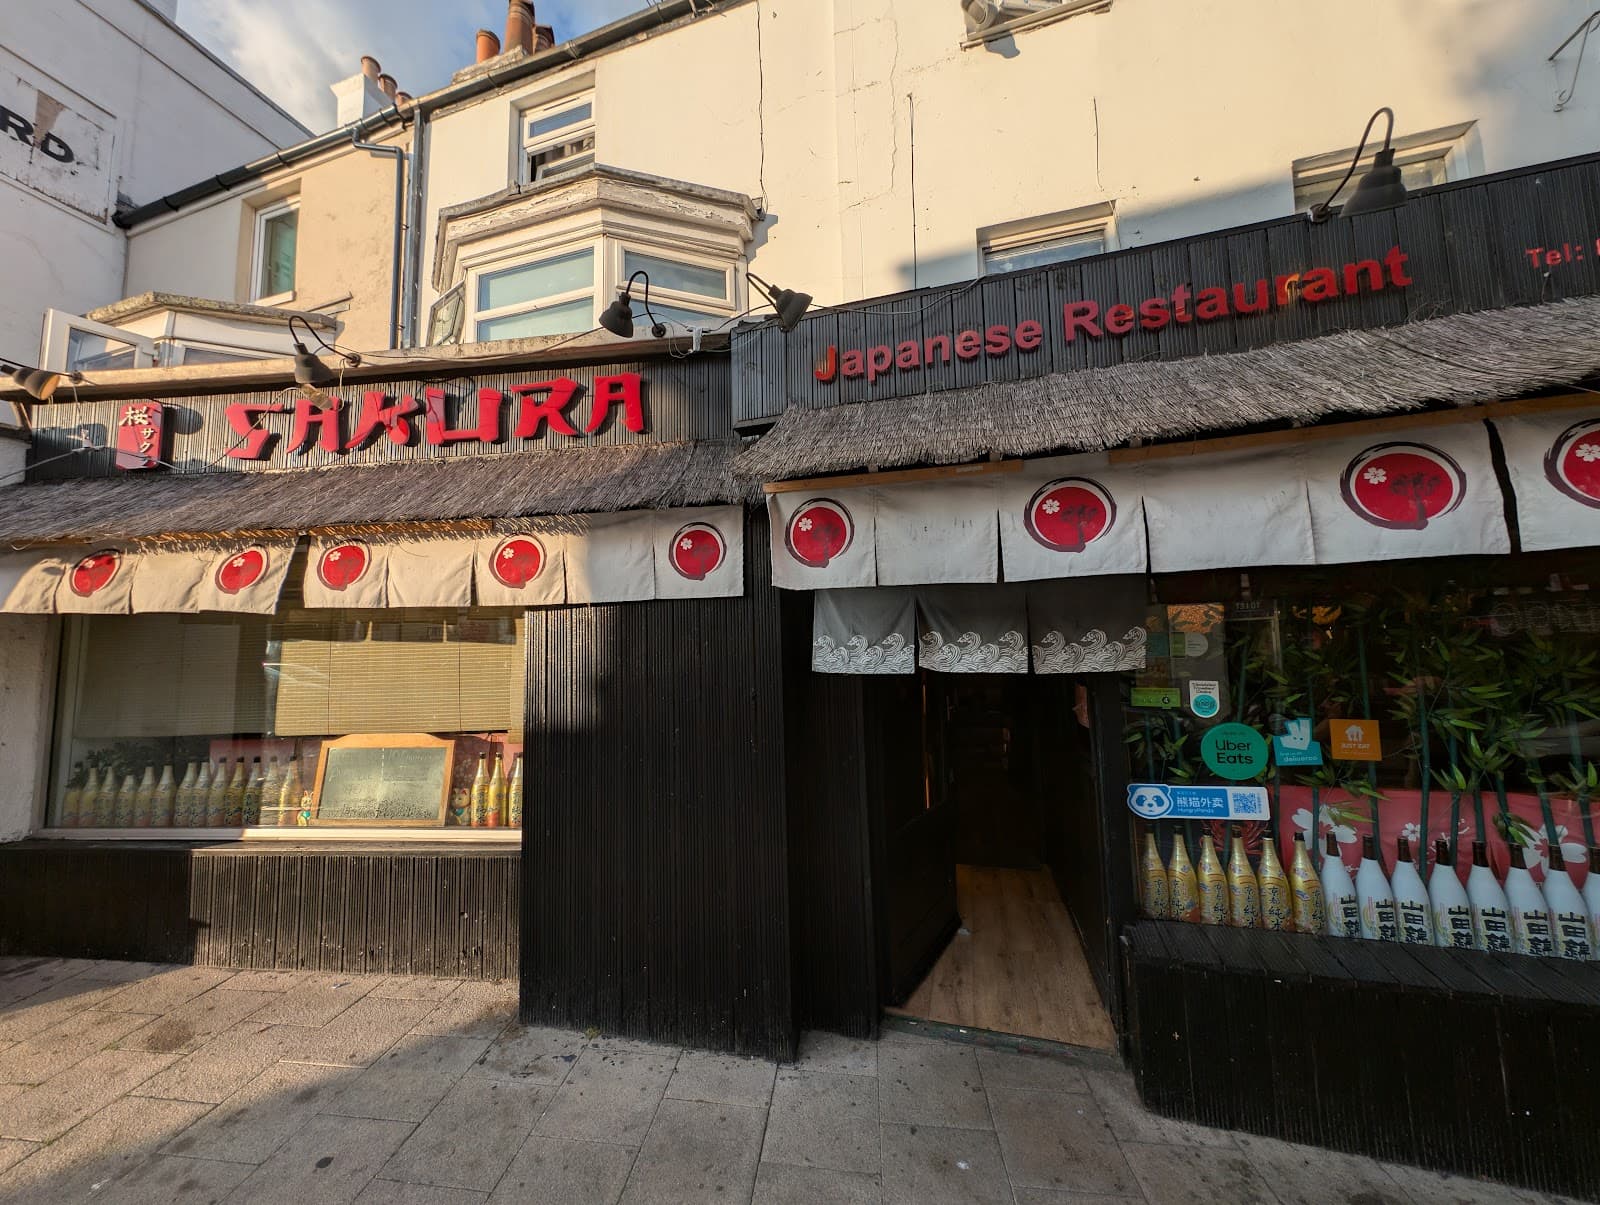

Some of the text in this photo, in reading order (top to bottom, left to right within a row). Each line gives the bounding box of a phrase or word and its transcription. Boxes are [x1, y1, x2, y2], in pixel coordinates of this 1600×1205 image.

[1525, 243, 1584, 269] Tel:
[814, 245, 1412, 384] Japanese Restaurant
[119, 406, 148, 426] 桜
[224, 371, 644, 459] SAKURA
[1215, 739, 1251, 751] Uber
[1216, 752, 1254, 765] Eats
[1176, 797, 1225, 809] 熊猫外卖
